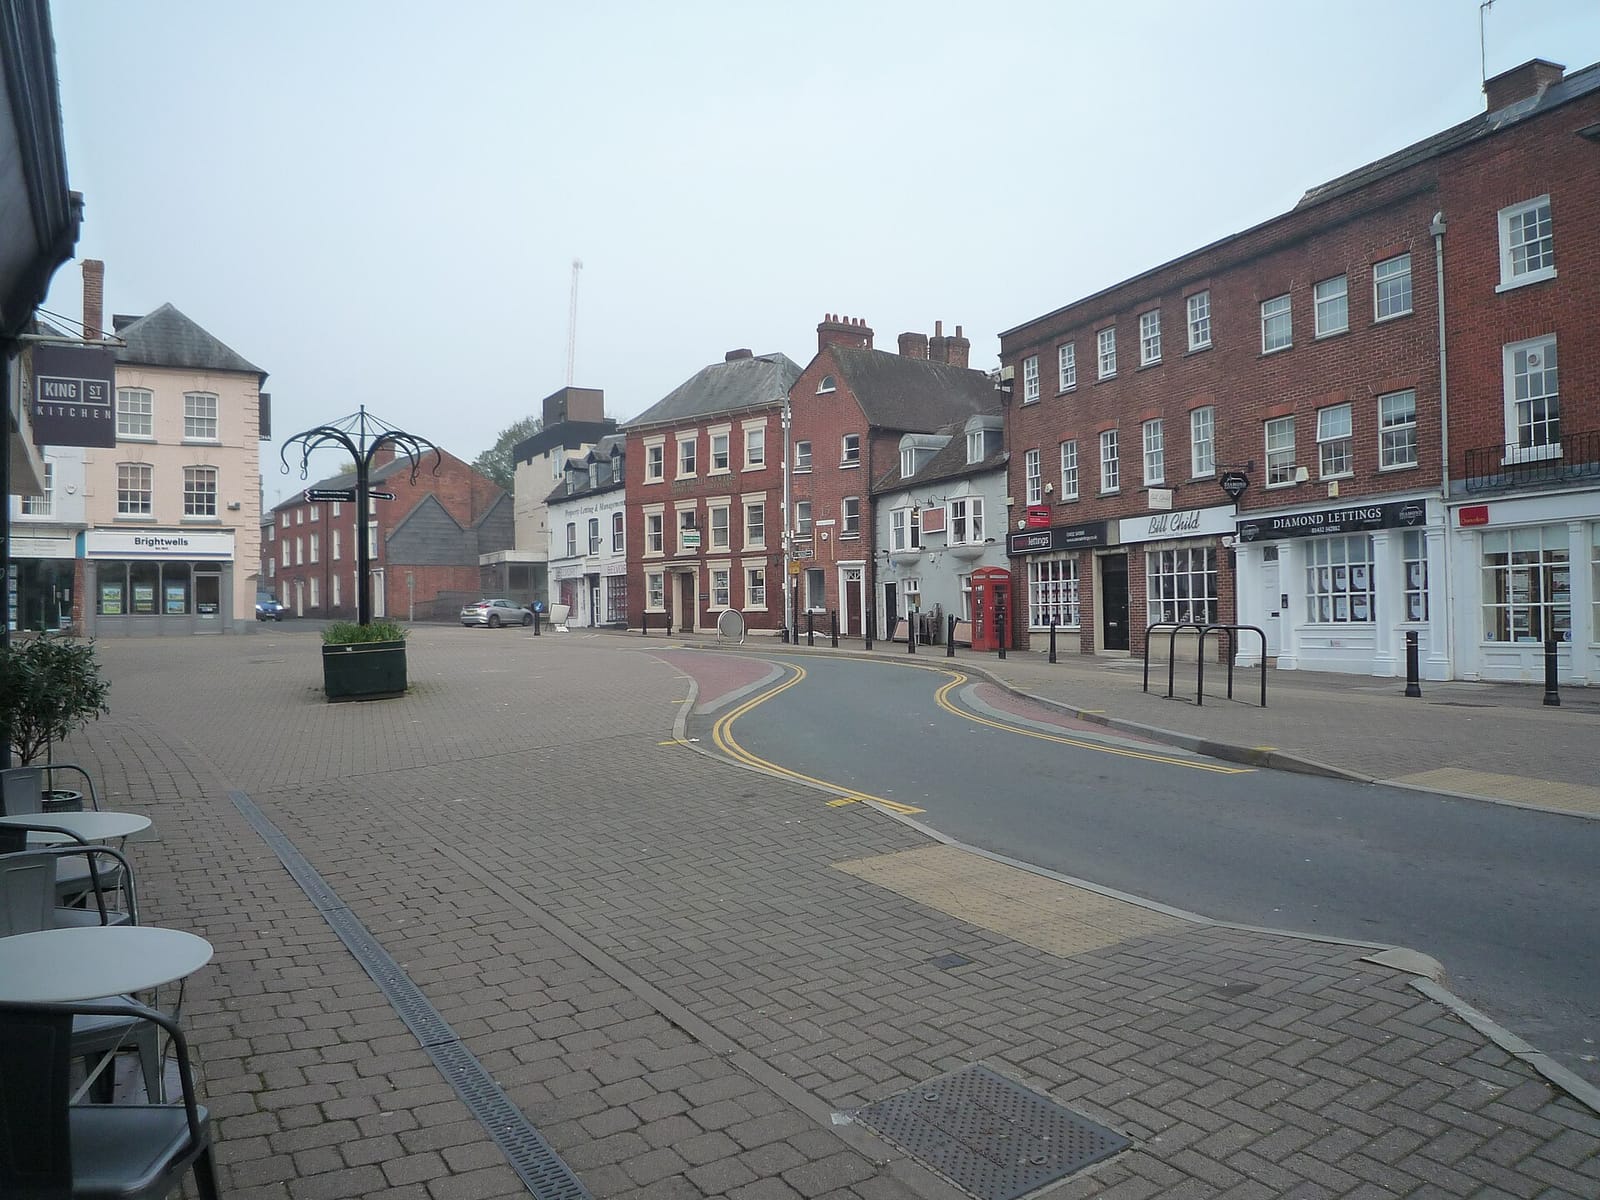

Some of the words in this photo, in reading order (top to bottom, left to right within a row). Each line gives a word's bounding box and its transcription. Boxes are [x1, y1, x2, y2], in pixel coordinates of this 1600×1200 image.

[45, 382, 77, 398] KING
[89, 385, 102, 396] ST
[37, 406, 111, 419] KITCHEN
[1148, 514, 1167, 534] Bill
[1170, 511, 1200, 532] Child
[1272, 514, 1324, 529] DIAMOND
[1327, 508, 1382, 523] LETTINGS
[134, 537, 189, 547] Brightwells
